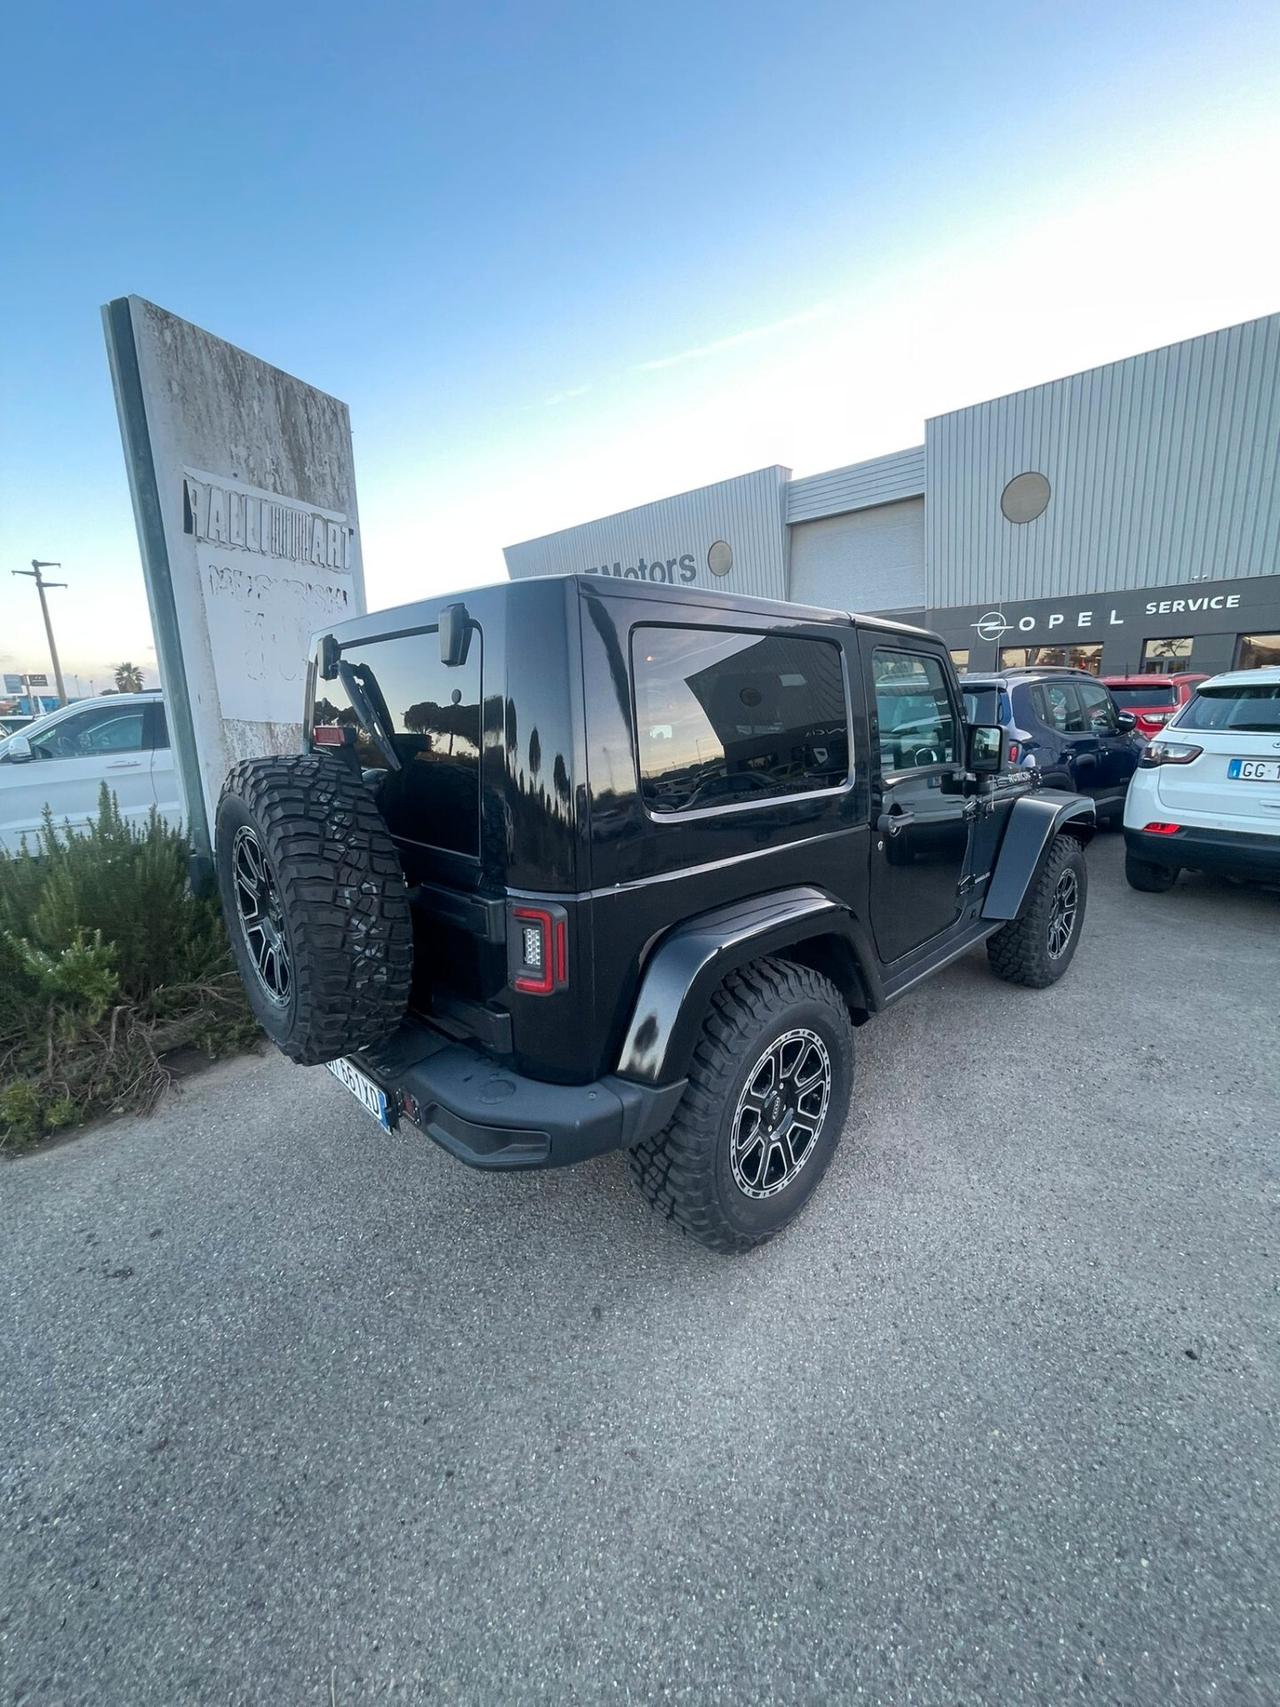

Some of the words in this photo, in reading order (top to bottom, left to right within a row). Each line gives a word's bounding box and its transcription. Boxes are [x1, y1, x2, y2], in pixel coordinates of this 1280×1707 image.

[1018, 610, 1124, 632] OPEL
[1145, 594, 1241, 615] SERVICE
[1242, 762, 1266, 778] GG
